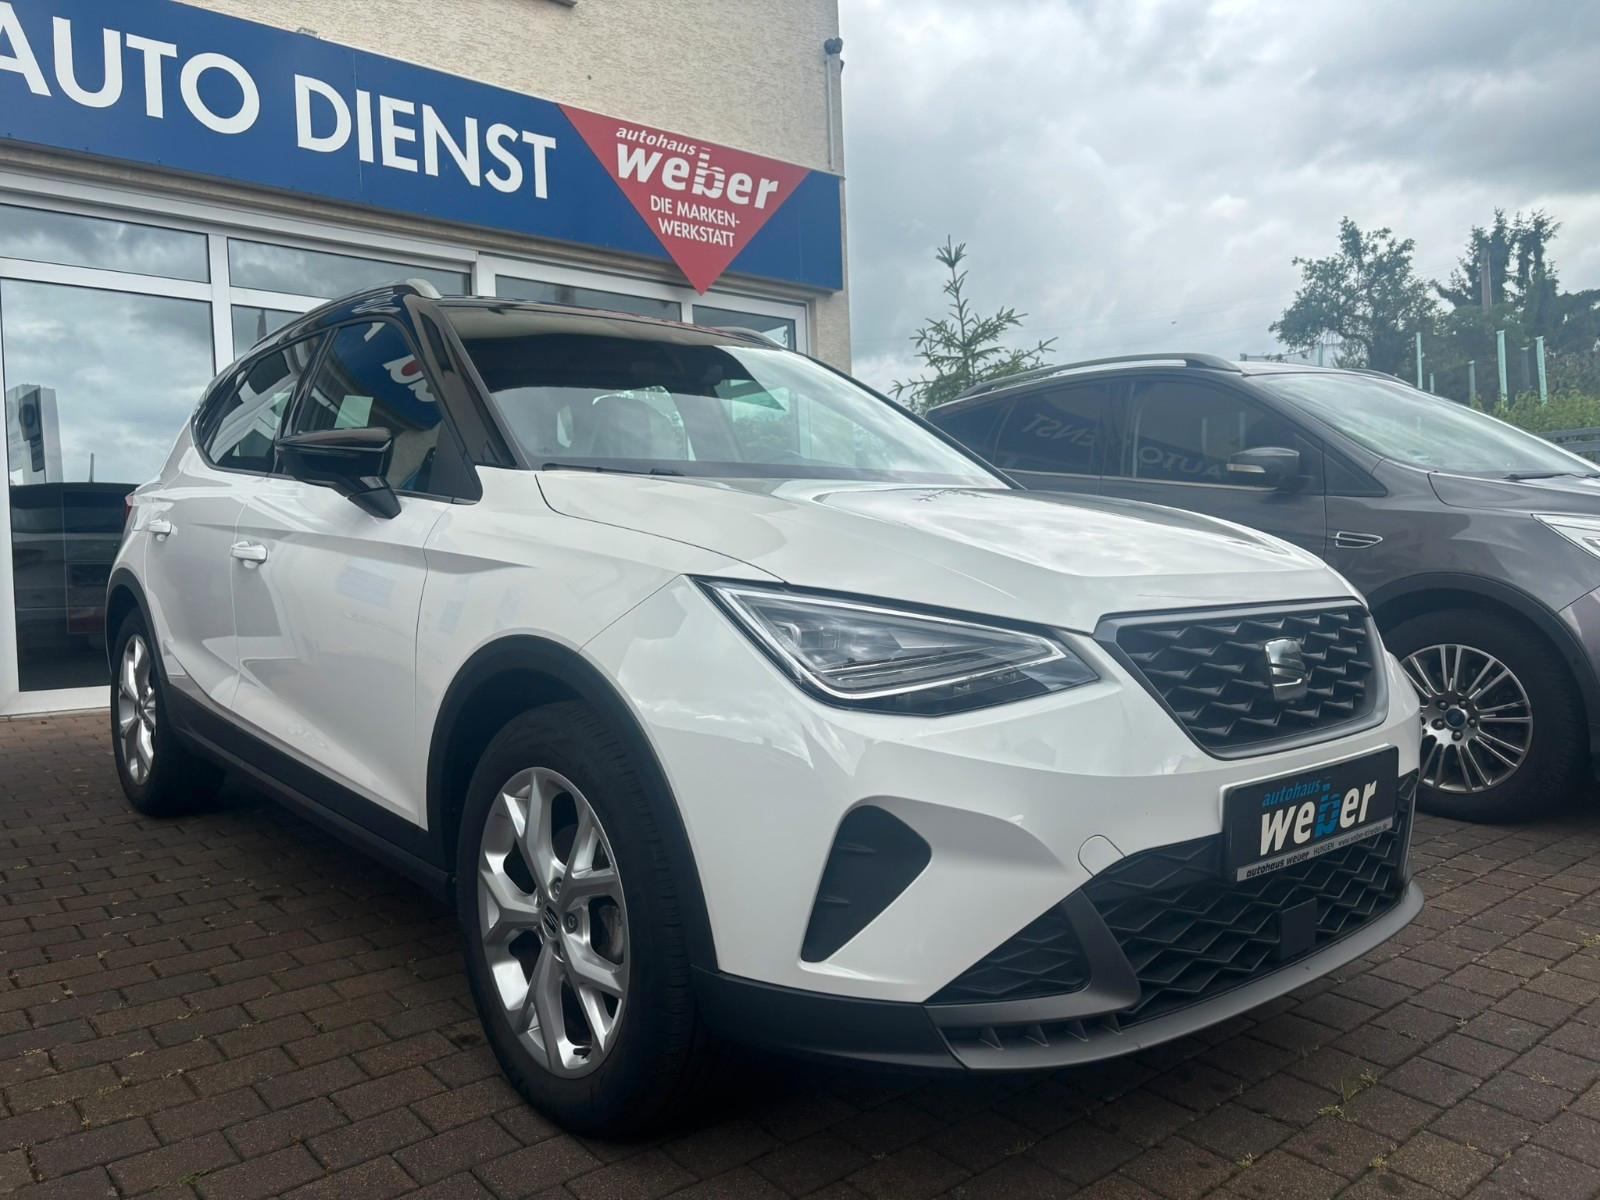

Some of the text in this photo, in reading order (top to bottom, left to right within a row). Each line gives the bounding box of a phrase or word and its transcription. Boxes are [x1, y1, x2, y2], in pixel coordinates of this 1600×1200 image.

[0, 2, 557, 200] AUTO DIENST
[615, 127, 697, 156] autohaus
[616, 143, 779, 209] weber
[650, 195, 740, 228] DIE MARKEN-
[658, 217, 735, 247] WERKSTATT
[1262, 779, 1321, 808] autohaus
[1260, 778, 1377, 857] weber
[1246, 859, 1284, 878] autohaus
